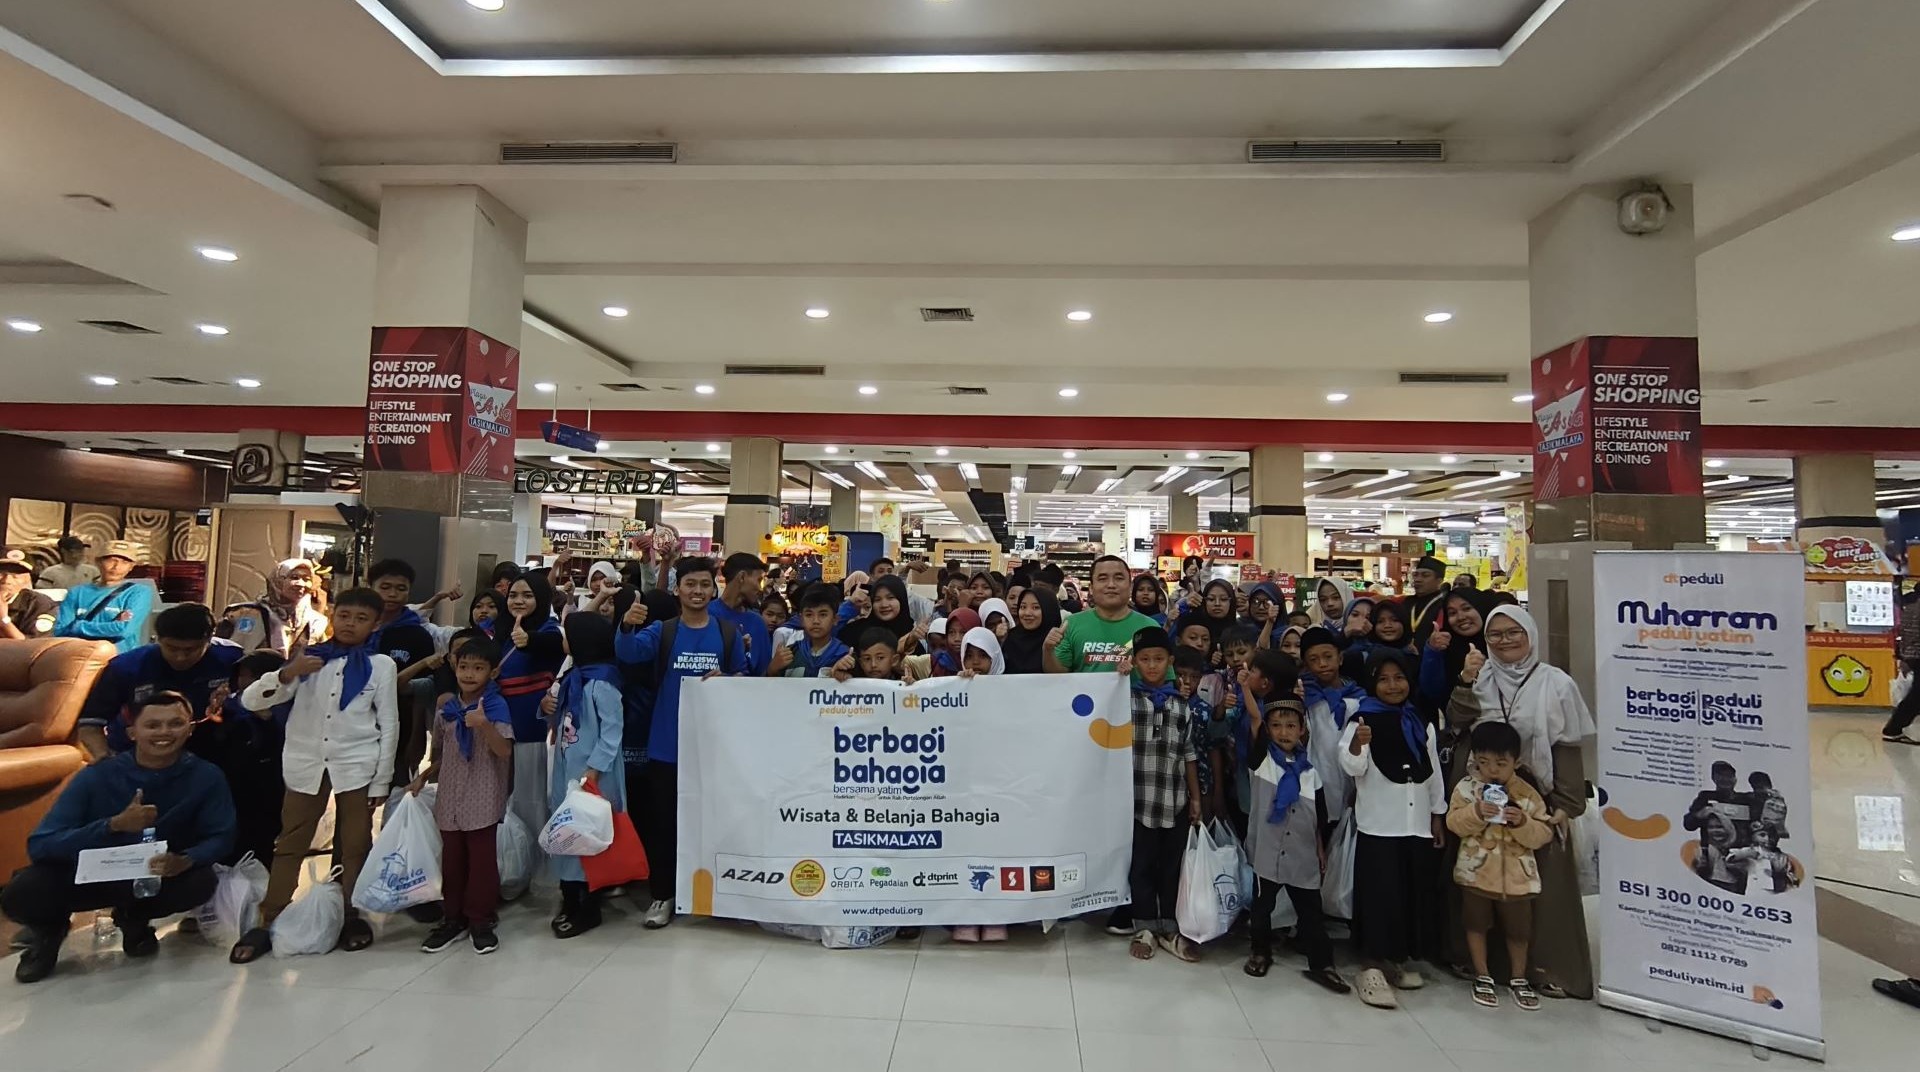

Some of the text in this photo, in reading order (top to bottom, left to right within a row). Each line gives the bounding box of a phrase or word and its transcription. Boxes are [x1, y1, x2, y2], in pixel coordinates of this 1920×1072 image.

[372, 361, 436, 372] ONE STOP
[371, 374, 462, 389] SHOPPING
[1594, 374, 1668, 386] ONE STOP
[1594, 387, 1700, 404] SHOPPING
[370, 401, 415, 411] LIFESTYLE
[369, 412, 452, 422] ENTERTAINMENT
[1594, 417, 1648, 428] LIFESTYLE
[368, 424, 431, 434] RECREATION
[470, 417, 509, 435] TASIKMALAYA
[367, 436, 416, 445] & DINING
[1594, 430, 1691, 441] ENTERTAINMENT
[1539, 433, 1582, 452] TASIKMALAYA
[1594, 442, 1668, 453] RECREATION
[1594, 454, 1651, 464] & DINING
[1208, 536, 1236, 546] KING
[1664, 572, 1724, 587] dtpeduli
[1618, 600, 1778, 631] Muharram
[1638, 627, 1754, 647] peduli yatim
[1083, 642, 1115, 653] RISE
[678, 656, 718, 664] BEASISWA
[809, 689, 969, 712] Muharram dtpeduli
[1626, 686, 1762, 709] berbagi peduli
[820, 706, 874, 717] peduli yatim
[1626, 701, 1763, 726] bahagia yatim
[834, 726, 945, 764] berbagi
[834, 757, 945, 794] bahagia
[833, 784, 902, 796] bersama yatim
[780, 808, 1000, 826] Wisata & Belanja Bahagia
[834, 833, 937, 846] TASIKMALAYA
[721, 868, 785, 884] AZAD
[928, 871, 958, 883] dtprint
[1062, 873, 1078, 883] 242
[870, 879, 908, 888] Pegadaian
[1619, 880, 1650, 897] BSI
[1656, 887, 1691, 905] 300
[1697, 895, 1734, 914] 000
[1742, 903, 1793, 925] 2653
[842, 907, 923, 916] www.dtpeduli.org
[1661, 943, 1687, 955] 0822
[1691, 950, 1717, 961] 1112
[1649, 966, 1744, 994] peduliyatim.id
